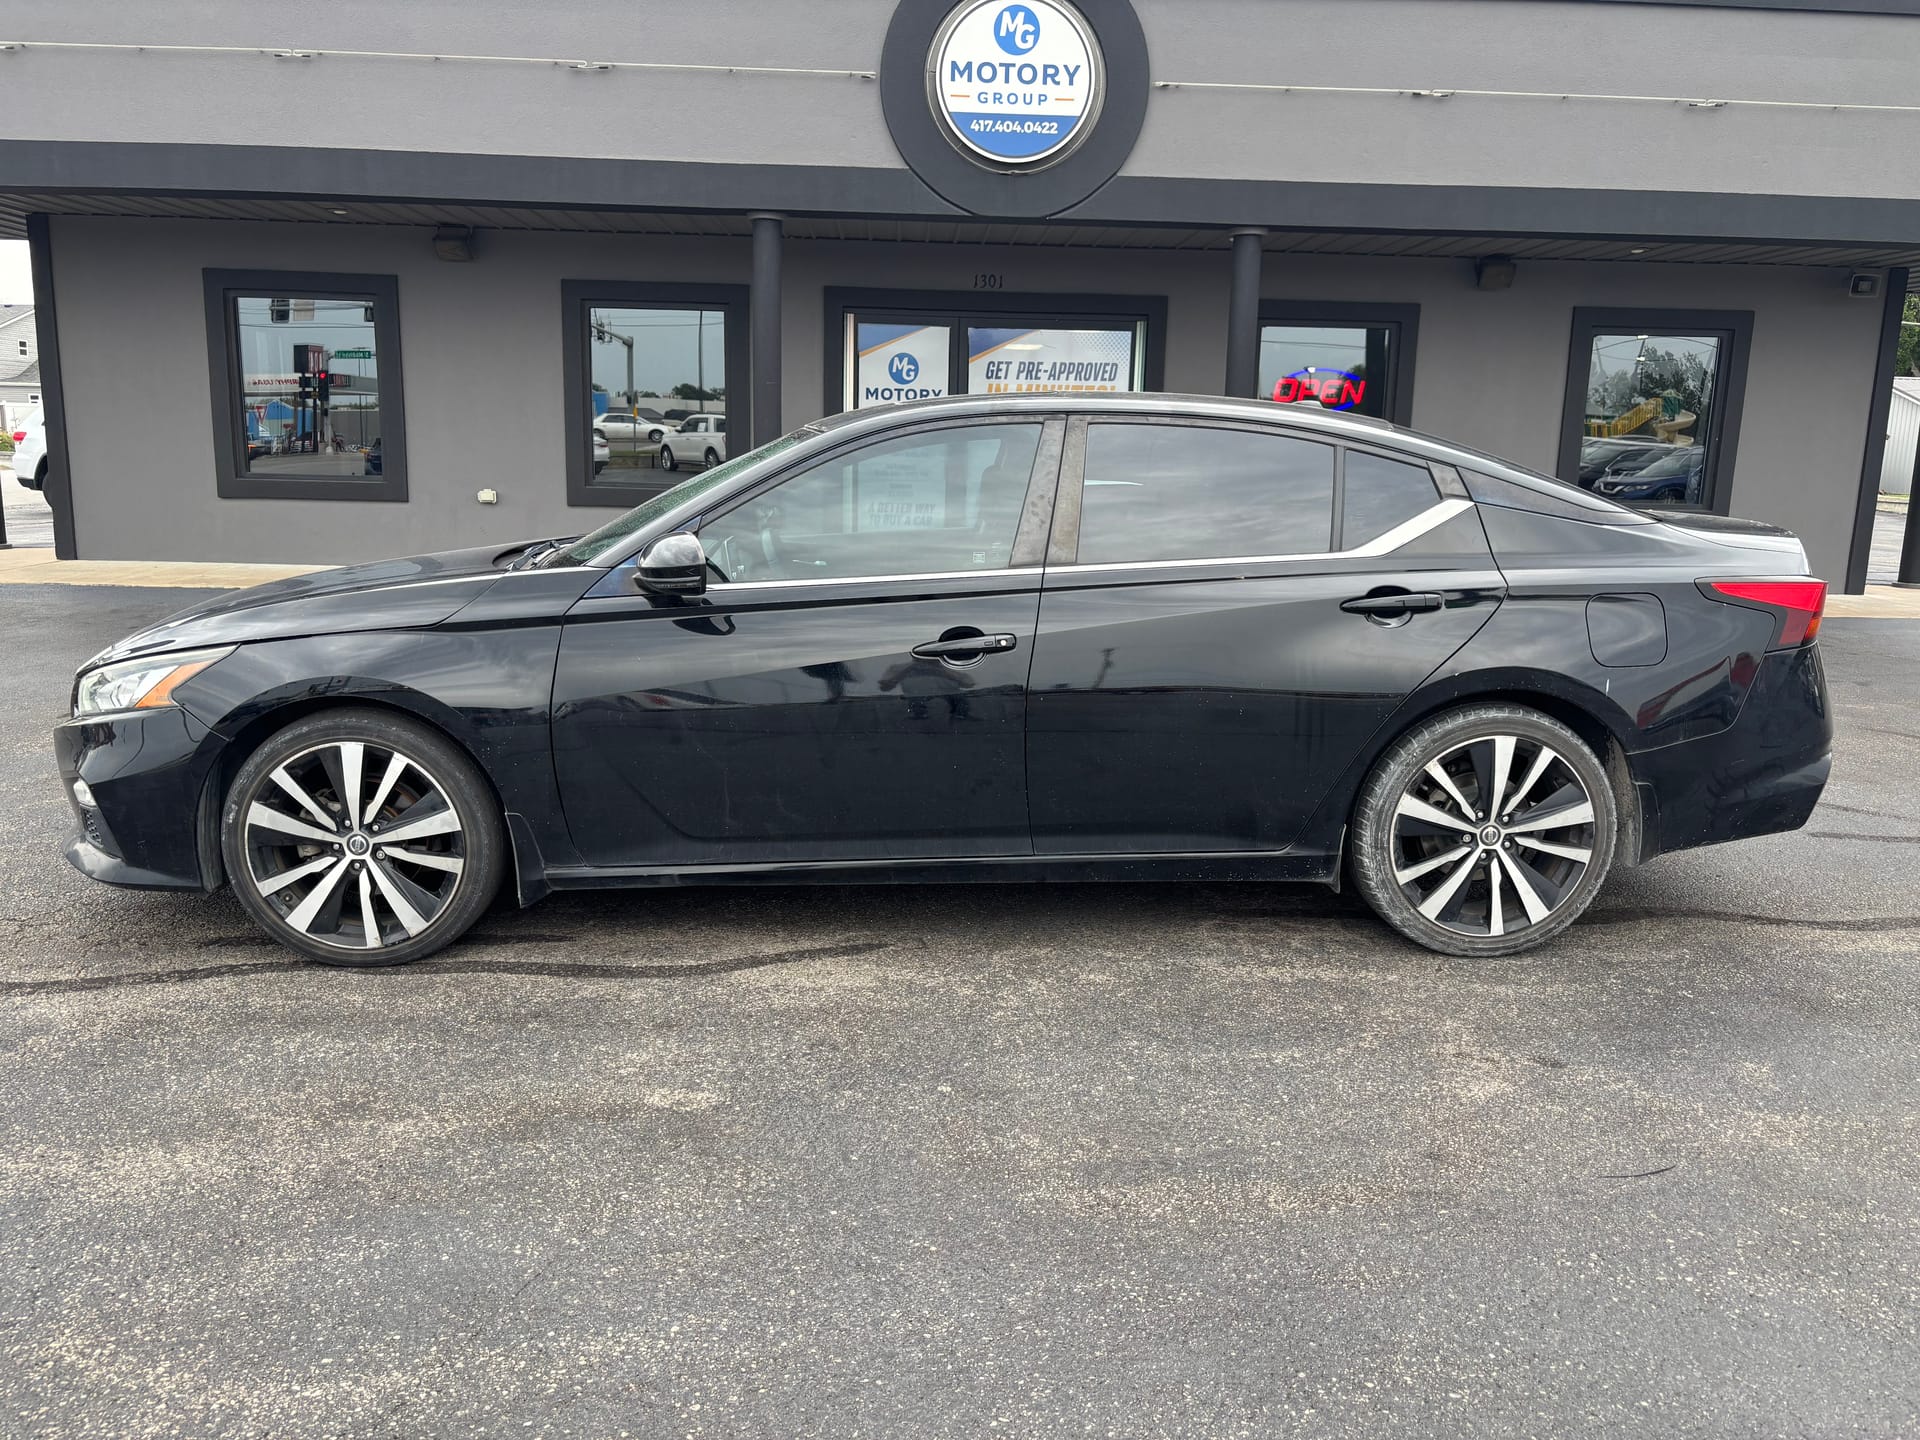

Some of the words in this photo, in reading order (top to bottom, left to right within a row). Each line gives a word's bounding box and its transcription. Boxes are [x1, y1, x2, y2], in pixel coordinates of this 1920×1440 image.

[999, 11, 1036, 50] MG
[950, 60, 1081, 86] MOTORY
[977, 91, 1048, 106] GROUP
[970, 119, 1058, 134] 417.404.0422
[972, 274, 1004, 289] 1301
[892, 356, 916, 380] MG
[985, 361, 1012, 381] GET
[1016, 361, 1119, 382] PRE-APPROVED
[865, 387, 943, 401] MOTORY
[1273, 377, 1366, 404] OPEN
[879, 502, 912, 513] BETTER
[915, 503, 936, 514] WAY
[913, 515, 933, 527] CAR
